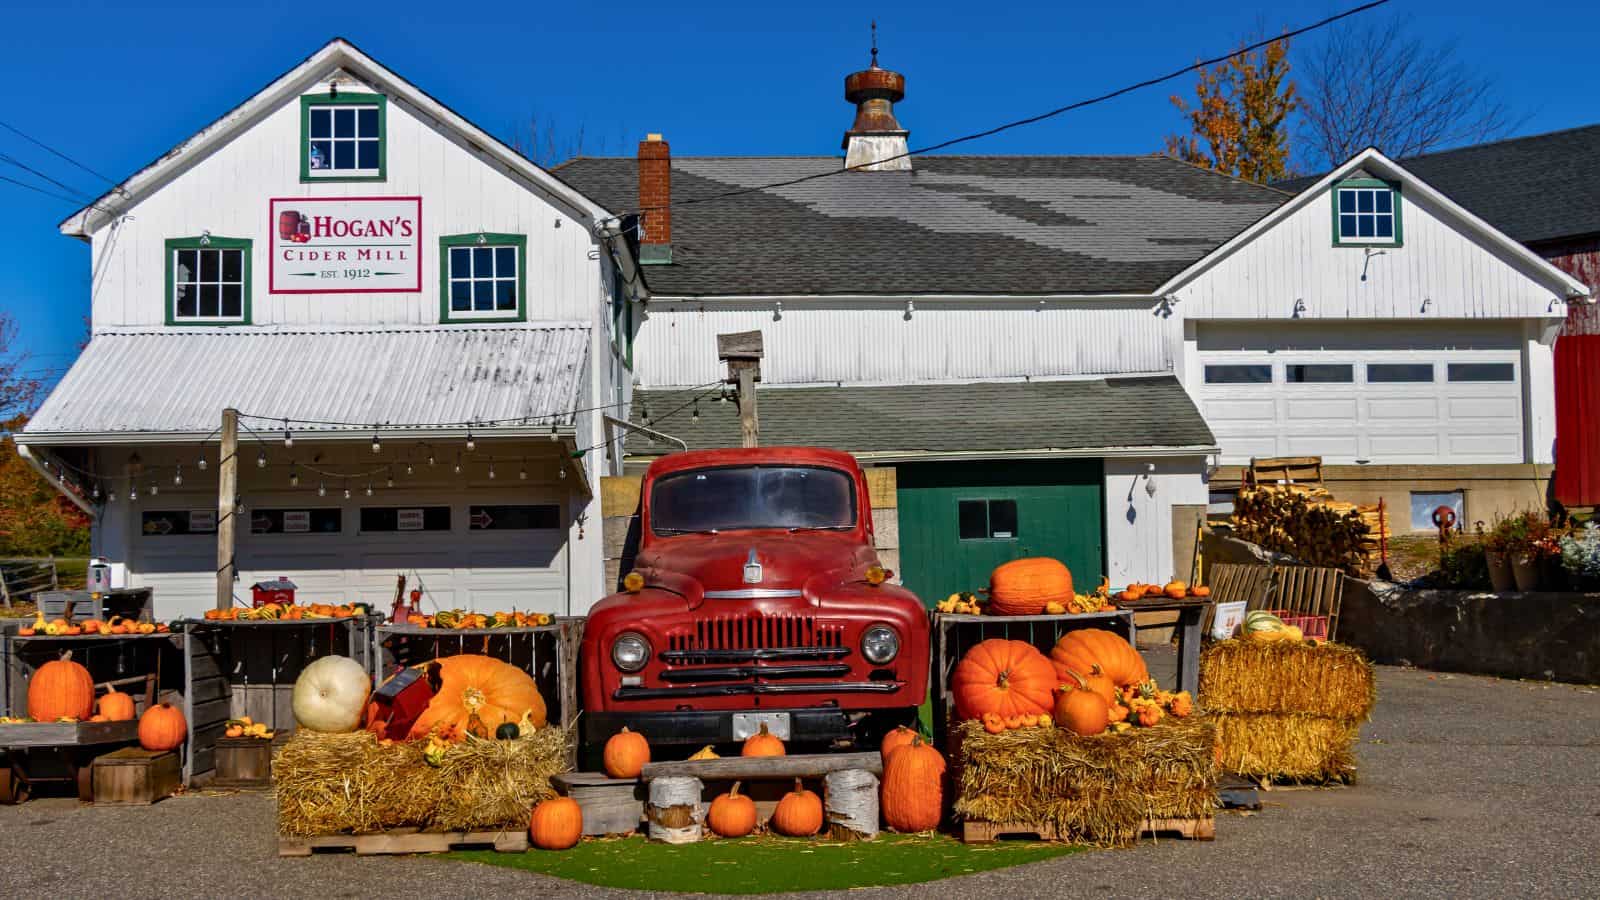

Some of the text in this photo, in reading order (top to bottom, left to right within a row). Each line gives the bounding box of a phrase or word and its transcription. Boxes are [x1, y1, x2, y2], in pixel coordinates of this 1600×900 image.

[313, 216, 413, 238] HOGAN'S
[283, 248, 408, 261] CIDER MILL
[343, 268, 370, 280] 1912
